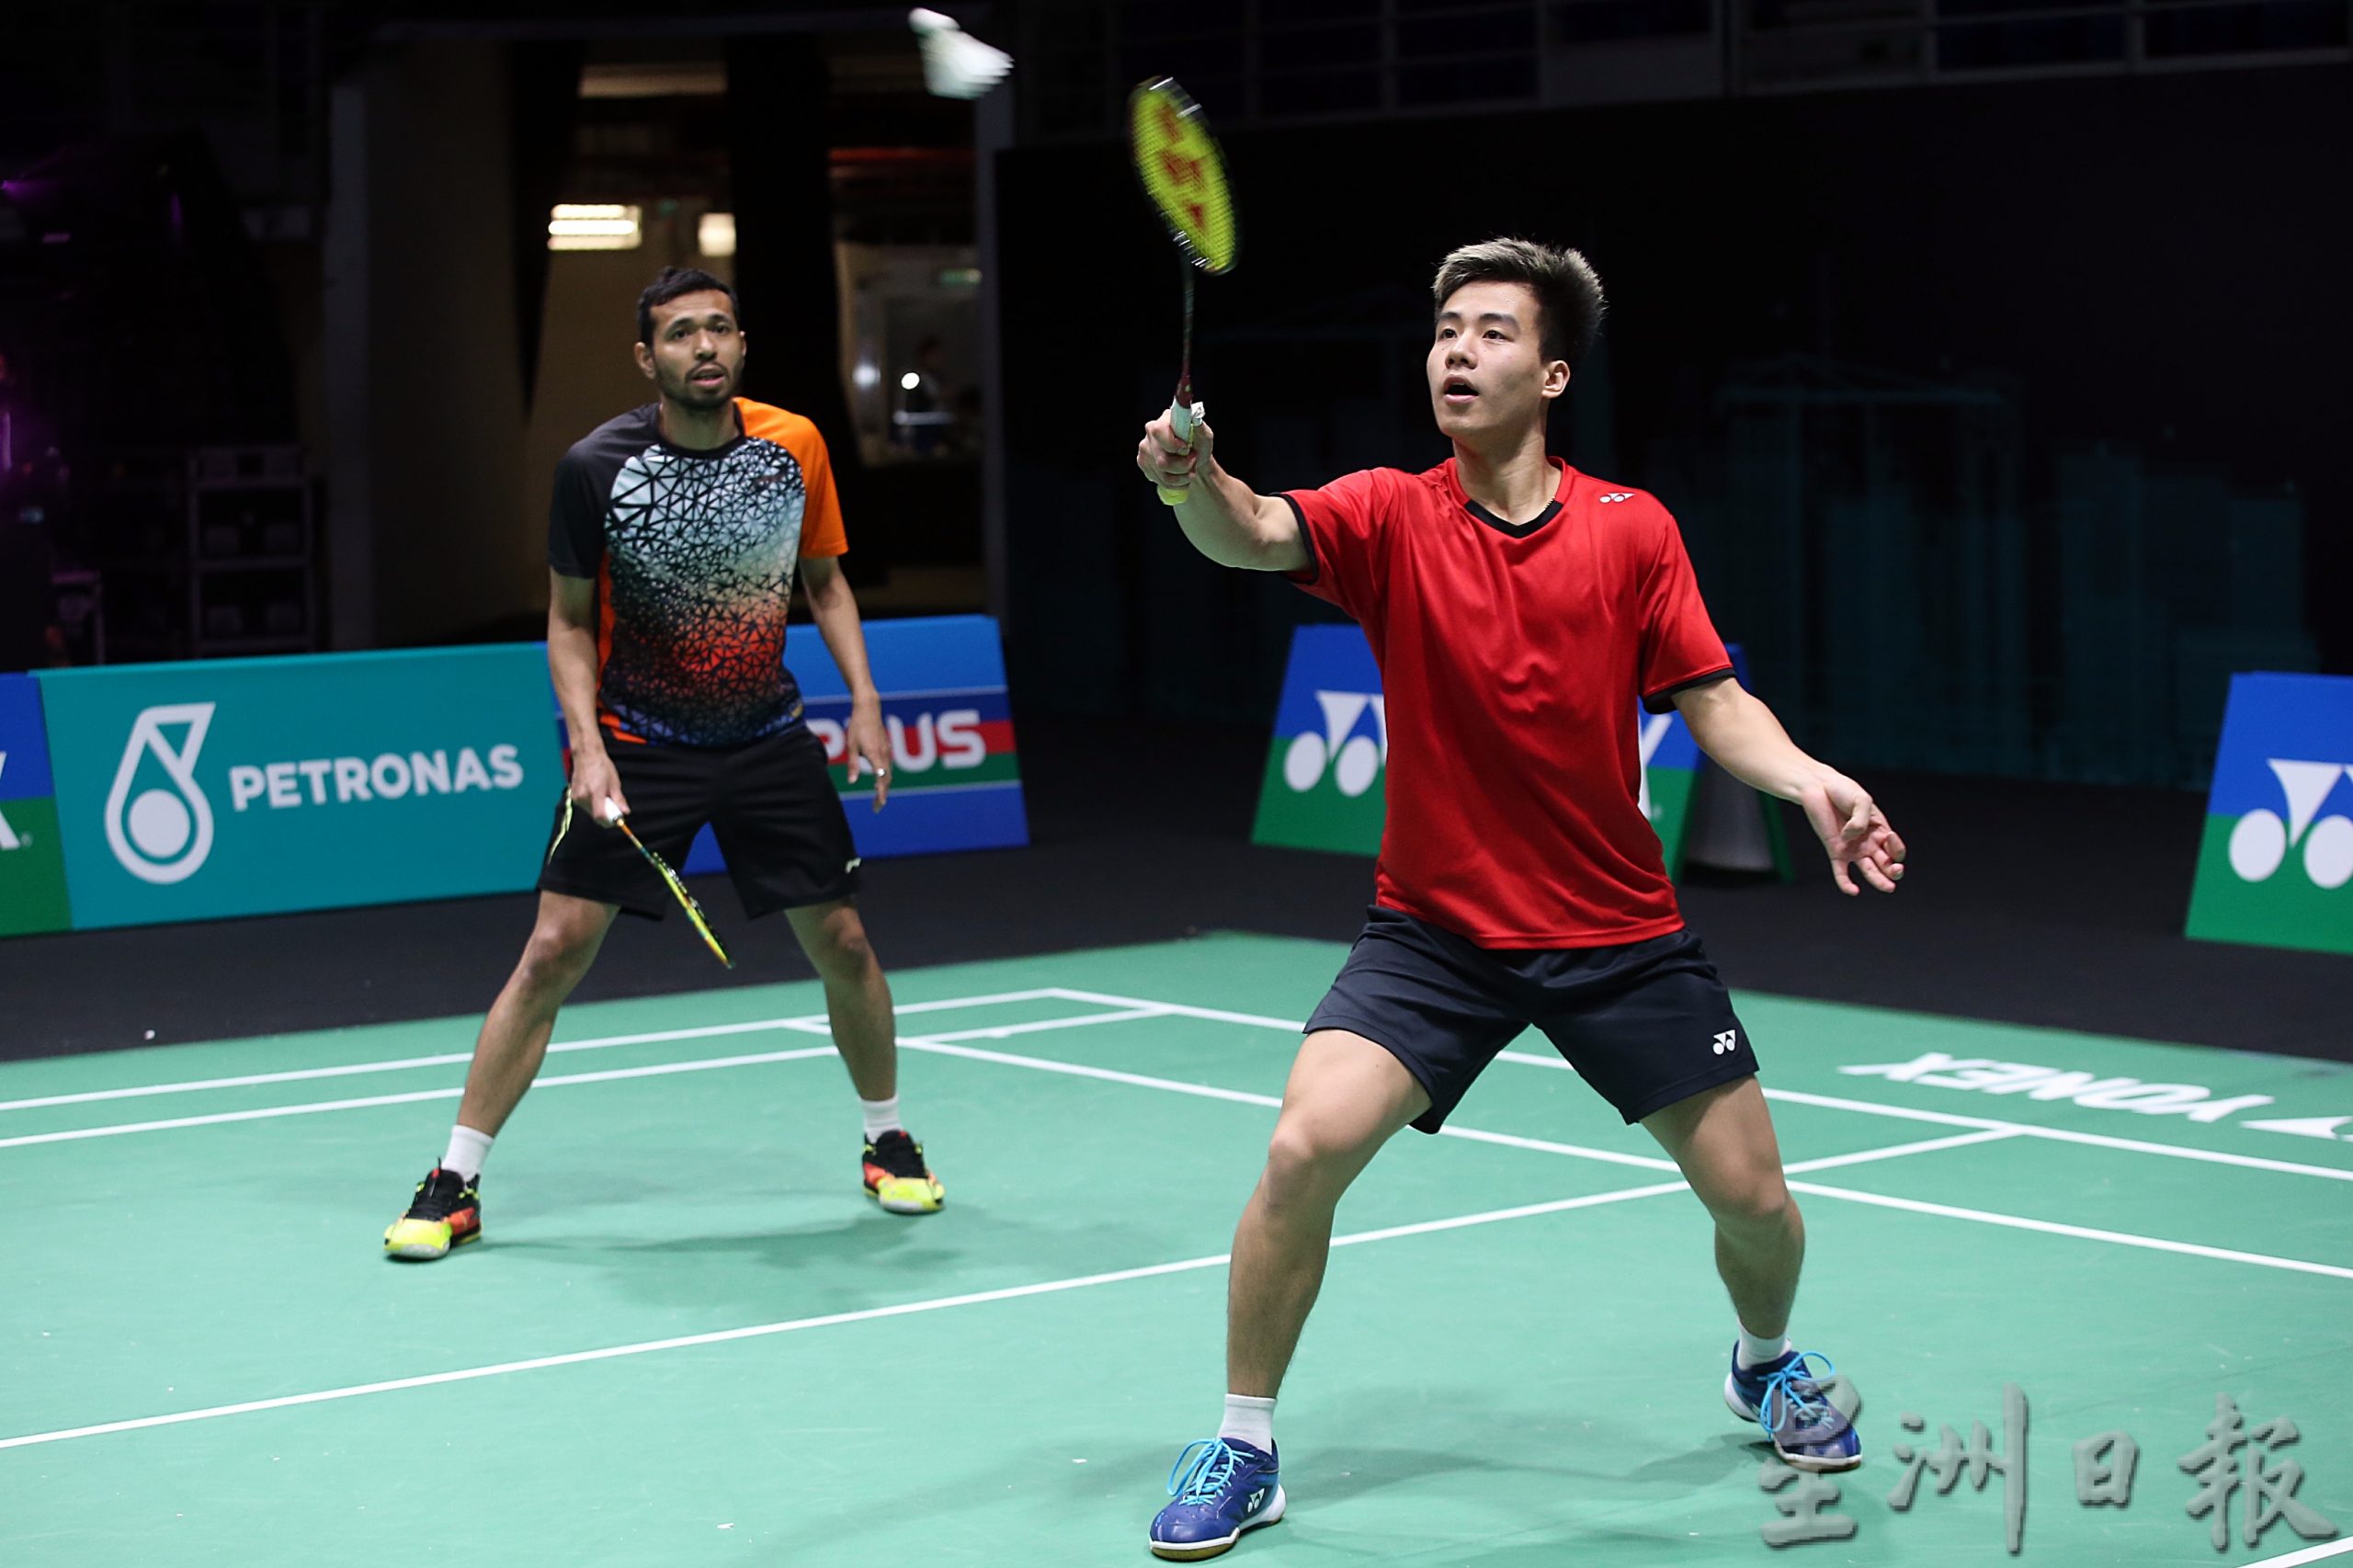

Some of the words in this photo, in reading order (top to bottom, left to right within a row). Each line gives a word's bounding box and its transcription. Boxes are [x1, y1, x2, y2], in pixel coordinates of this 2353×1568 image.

[806, 709, 986, 774] PUS
[228, 744, 524, 812] PETRONAS
[1837, 1052, 2275, 1122] YONEX
